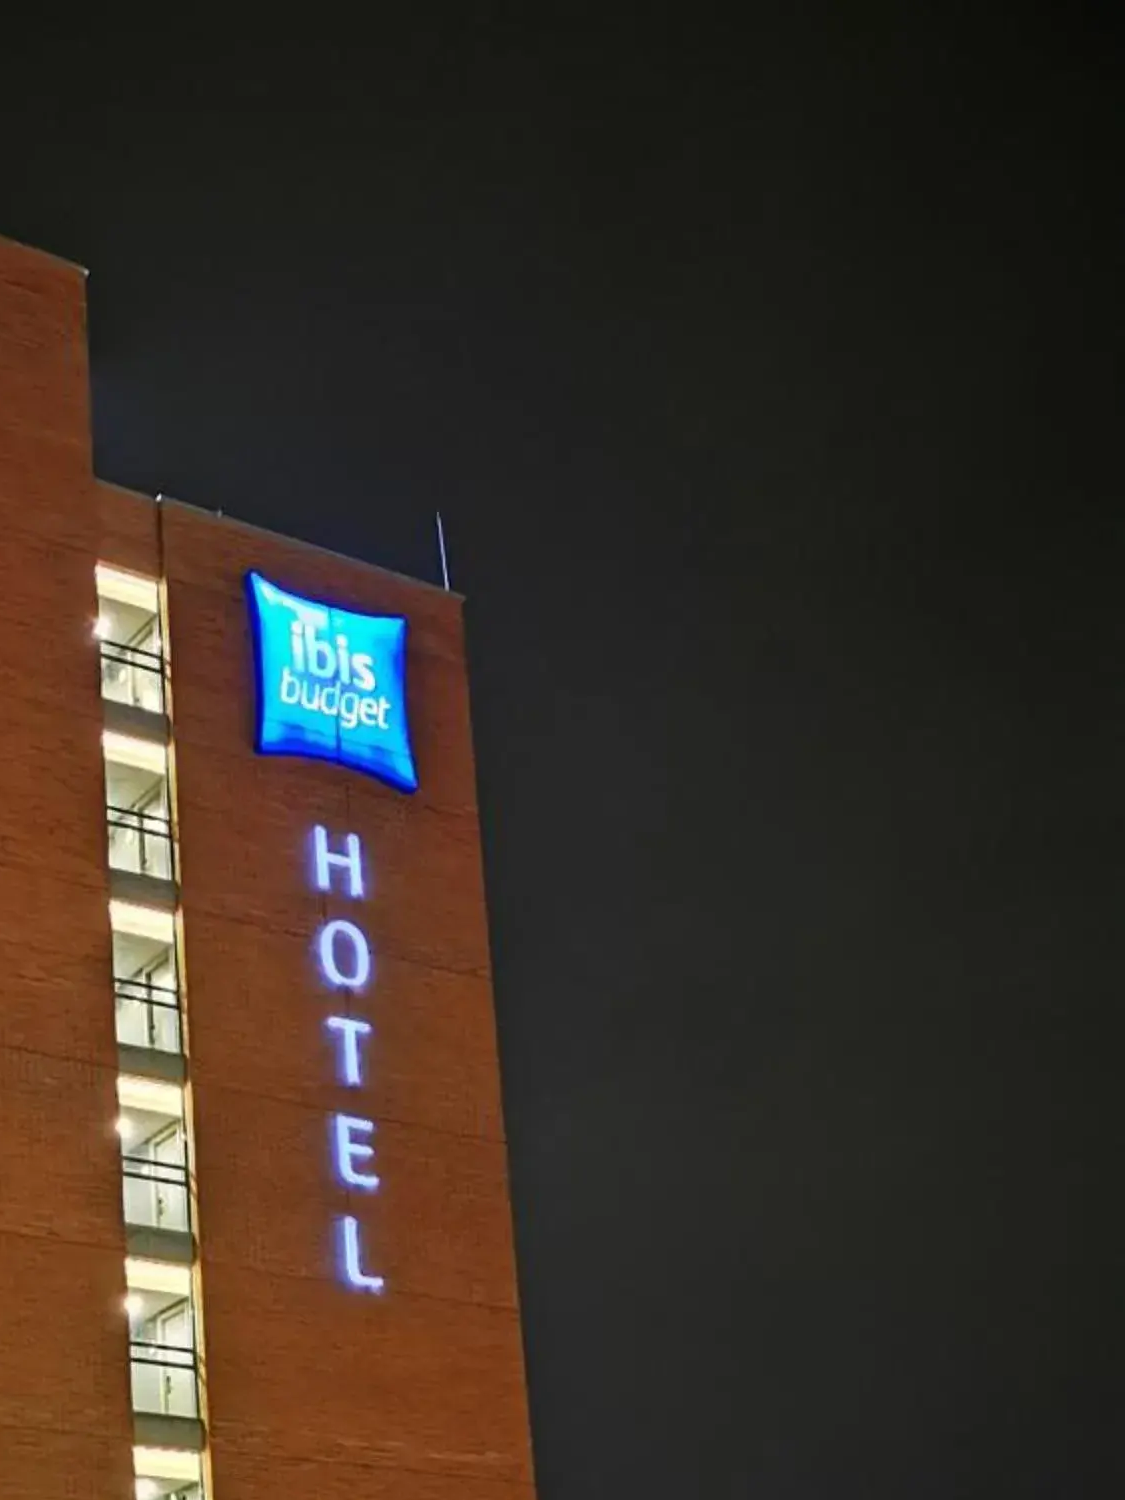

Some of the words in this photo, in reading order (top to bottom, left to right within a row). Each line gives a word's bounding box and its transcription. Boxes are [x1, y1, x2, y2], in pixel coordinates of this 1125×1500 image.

[290, 618, 376, 692] ibis
[280, 666, 391, 730] budget
[312, 824, 384, 1292] HOTEL
